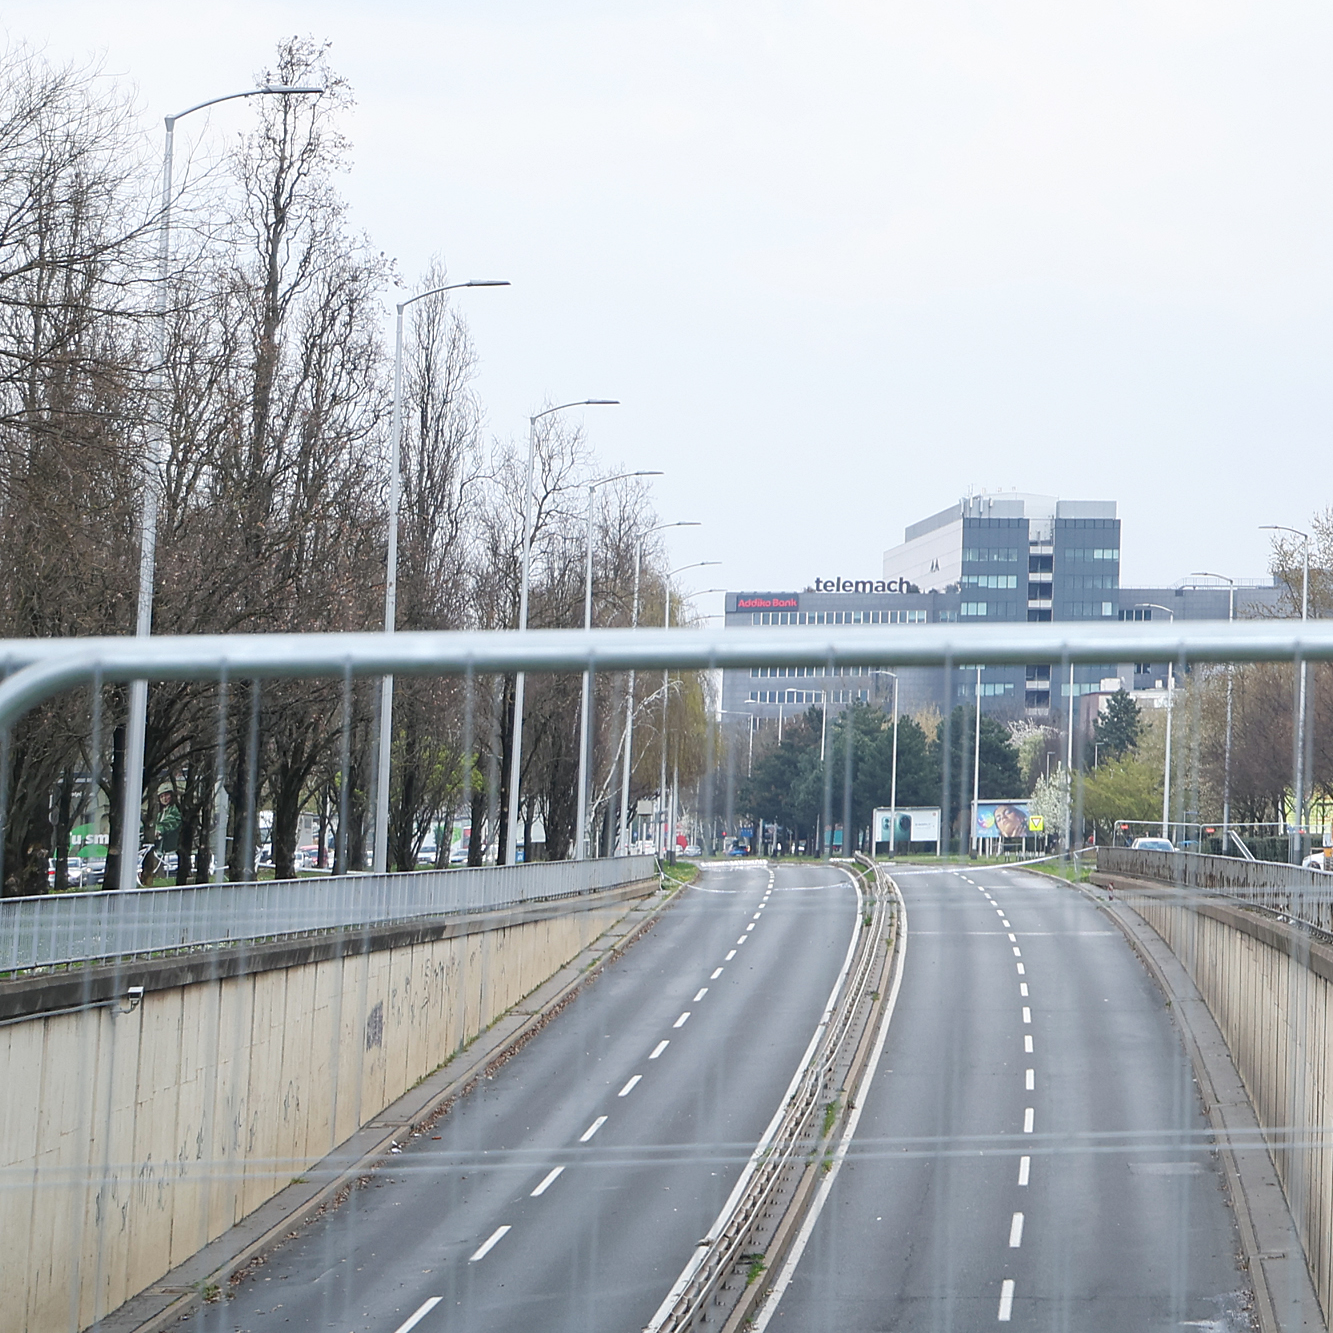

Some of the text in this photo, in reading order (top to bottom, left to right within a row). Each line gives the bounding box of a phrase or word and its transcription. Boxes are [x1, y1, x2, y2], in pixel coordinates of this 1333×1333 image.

[815, 576, 911, 594] telemach
[738, 598, 798, 608] Addiko Bank
